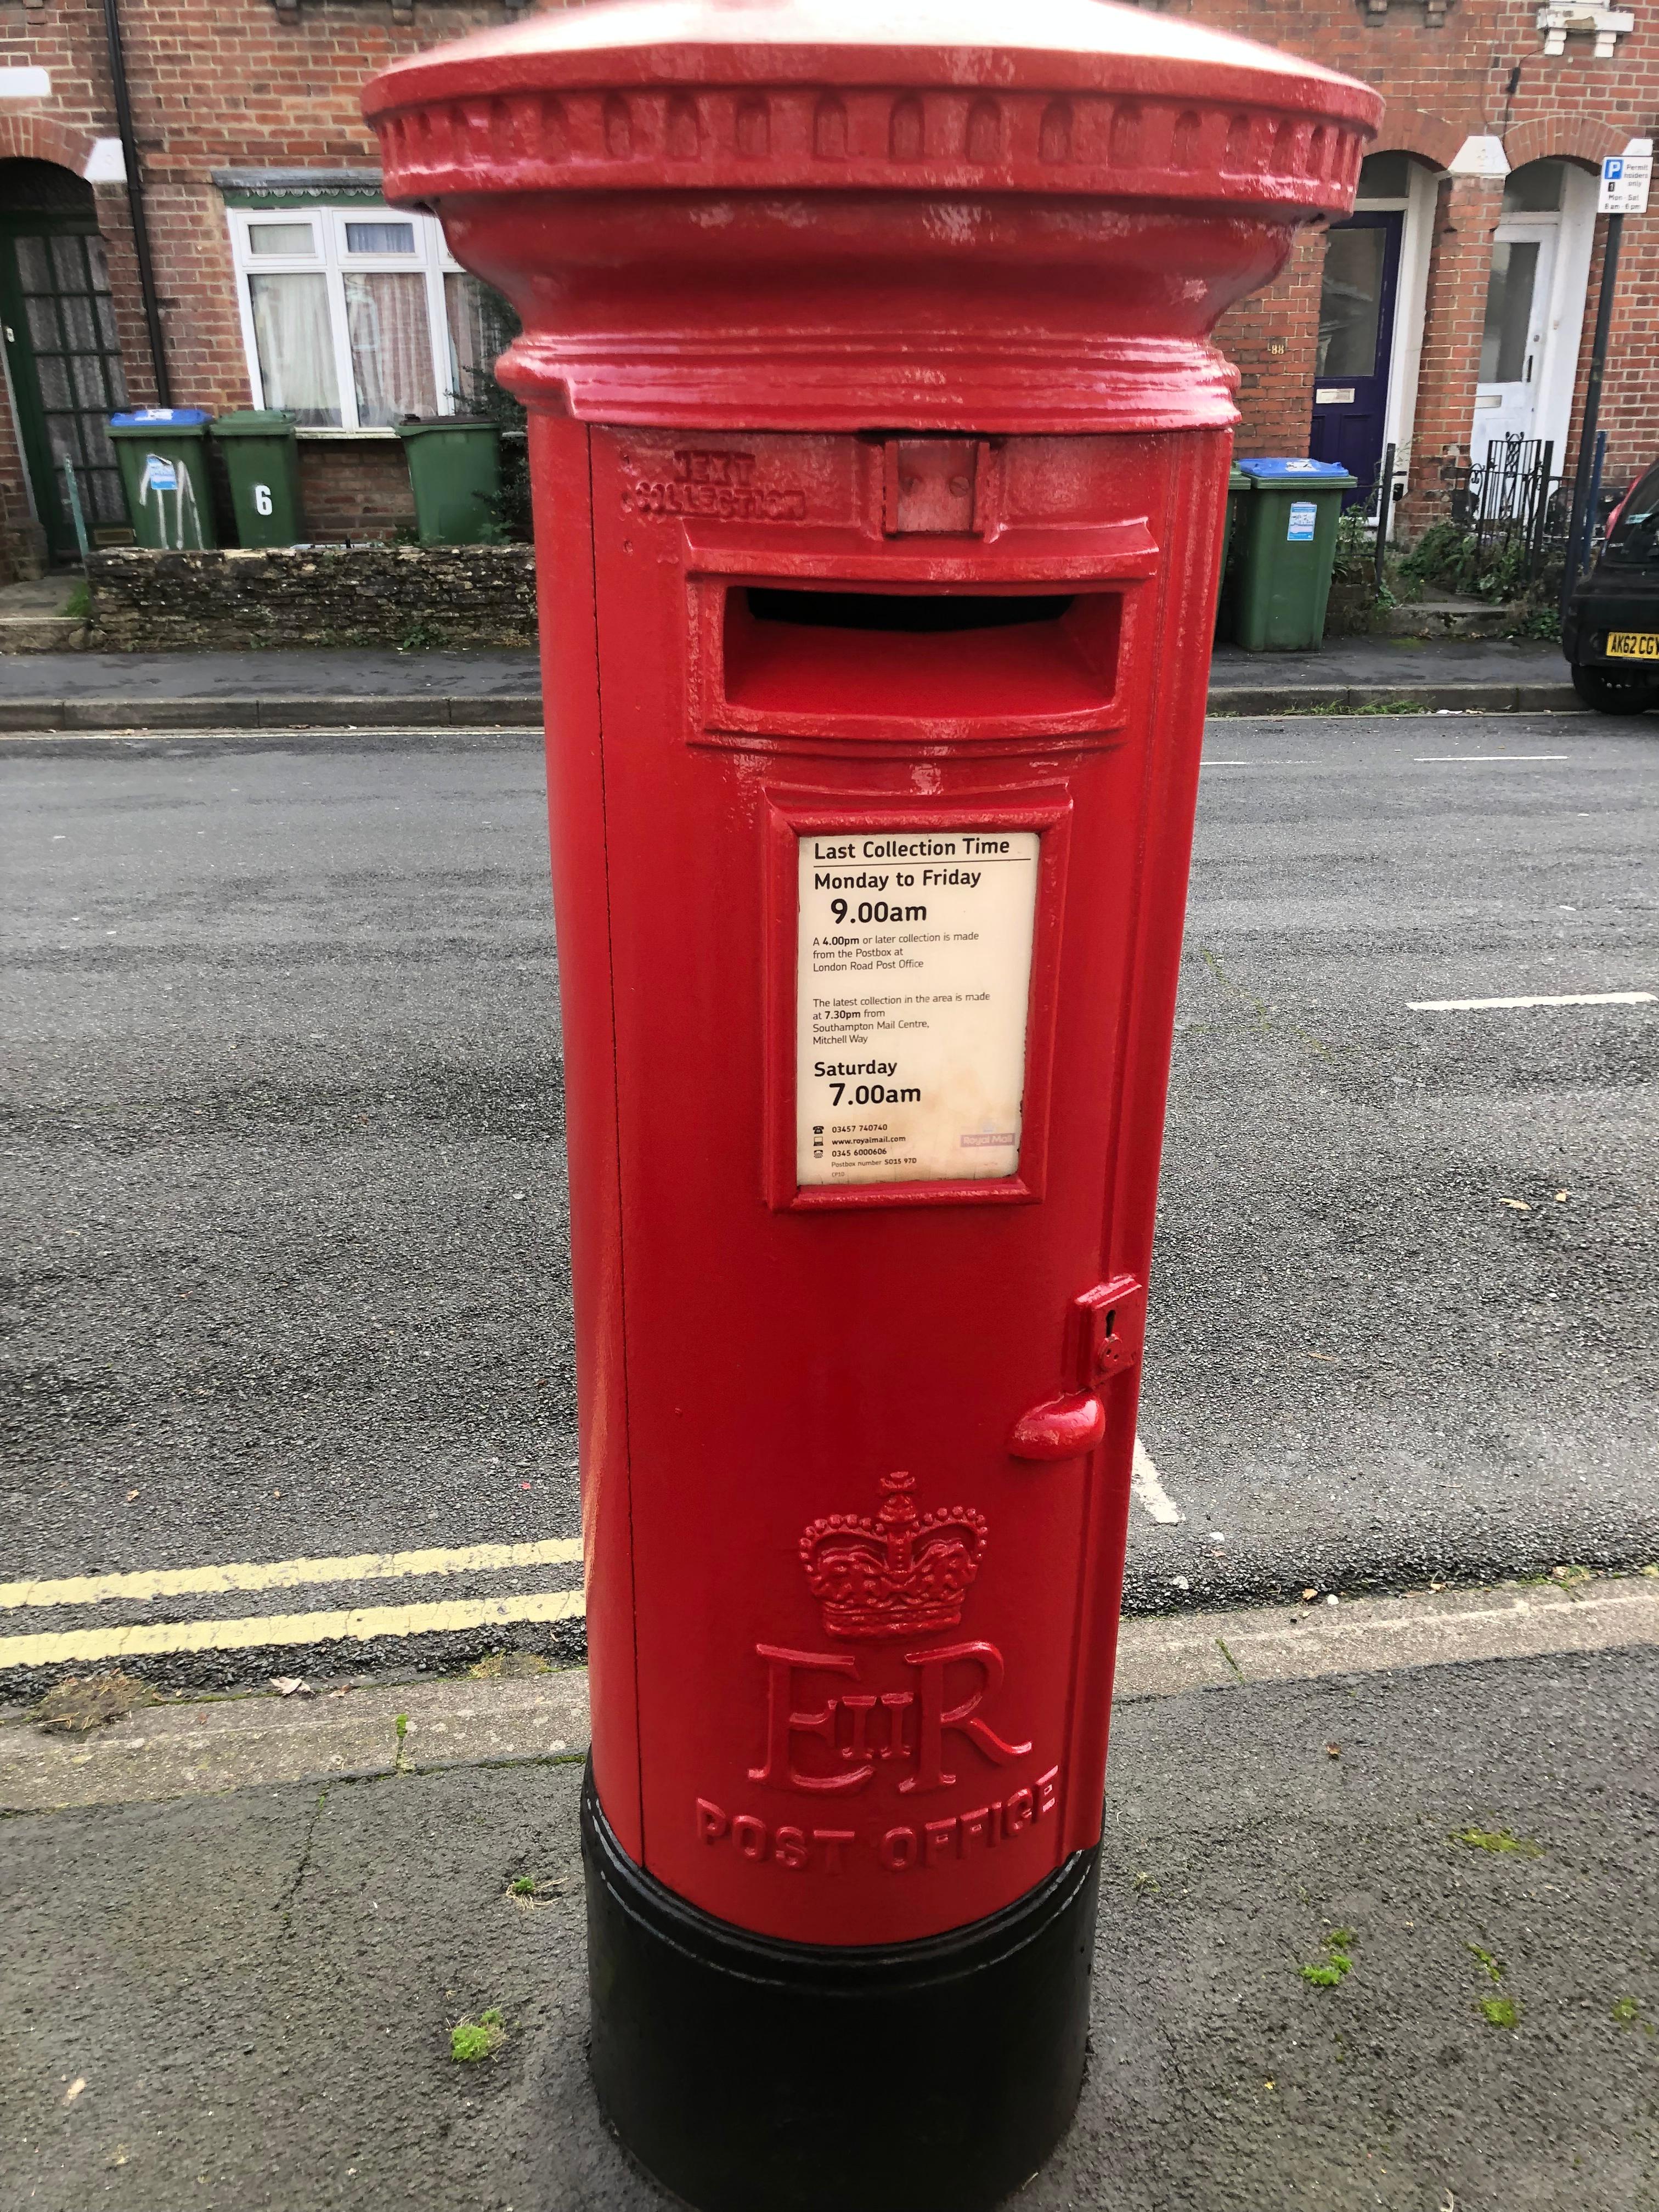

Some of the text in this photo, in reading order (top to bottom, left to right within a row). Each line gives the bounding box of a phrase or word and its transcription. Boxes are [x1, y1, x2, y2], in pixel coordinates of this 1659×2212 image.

[1609, 161, 1621, 178] P
[255, 484, 273, 516] 6
[635, 482, 806, 521] COLLECTION
[1611, 634, 1637, 654] AK62
[815, 837, 1009, 860] Last Collection Time
[815, 868, 981, 891] Monday to Friday
[831, 898, 927, 924] 9.00am
[812, 937, 820, 946] A
[822, 936, 860, 947] 4.00pm
[875, 935, 896, 944] later
[899, 934, 940, 943] collection
[943, 933, 951, 941] is
[953, 932, 979, 941] made
[812, 947, 904, 959] from the Postbox at
[813, 959, 924, 972] London Road Post Office
[812, 998, 831, 1008] The
[833, 998, 858, 1007] latest
[860, 996, 901, 1006] collection
[904, 995, 913, 1003] in
[915, 994, 930, 1003] the
[965, 992, 990, 1001] made
[812, 1009, 885, 1020] at 7.30pm from
[812, 1020, 929, 1033] Southampton Mail Centre,
[813, 1034, 868, 1045] Mitchell Way
[814, 1059, 898, 1077] Saturday
[829, 1082, 921, 1107] 7.00am
[832, 1124, 888, 1133] 03457 740740
[832, 1136, 906, 1146] www.royalmail.com
[963, 1135, 1013, 1146] Royal Mail
[853, 1148, 887, 1156] 6000606
[695, 1764, 1059, 1873] POST OFFICE
